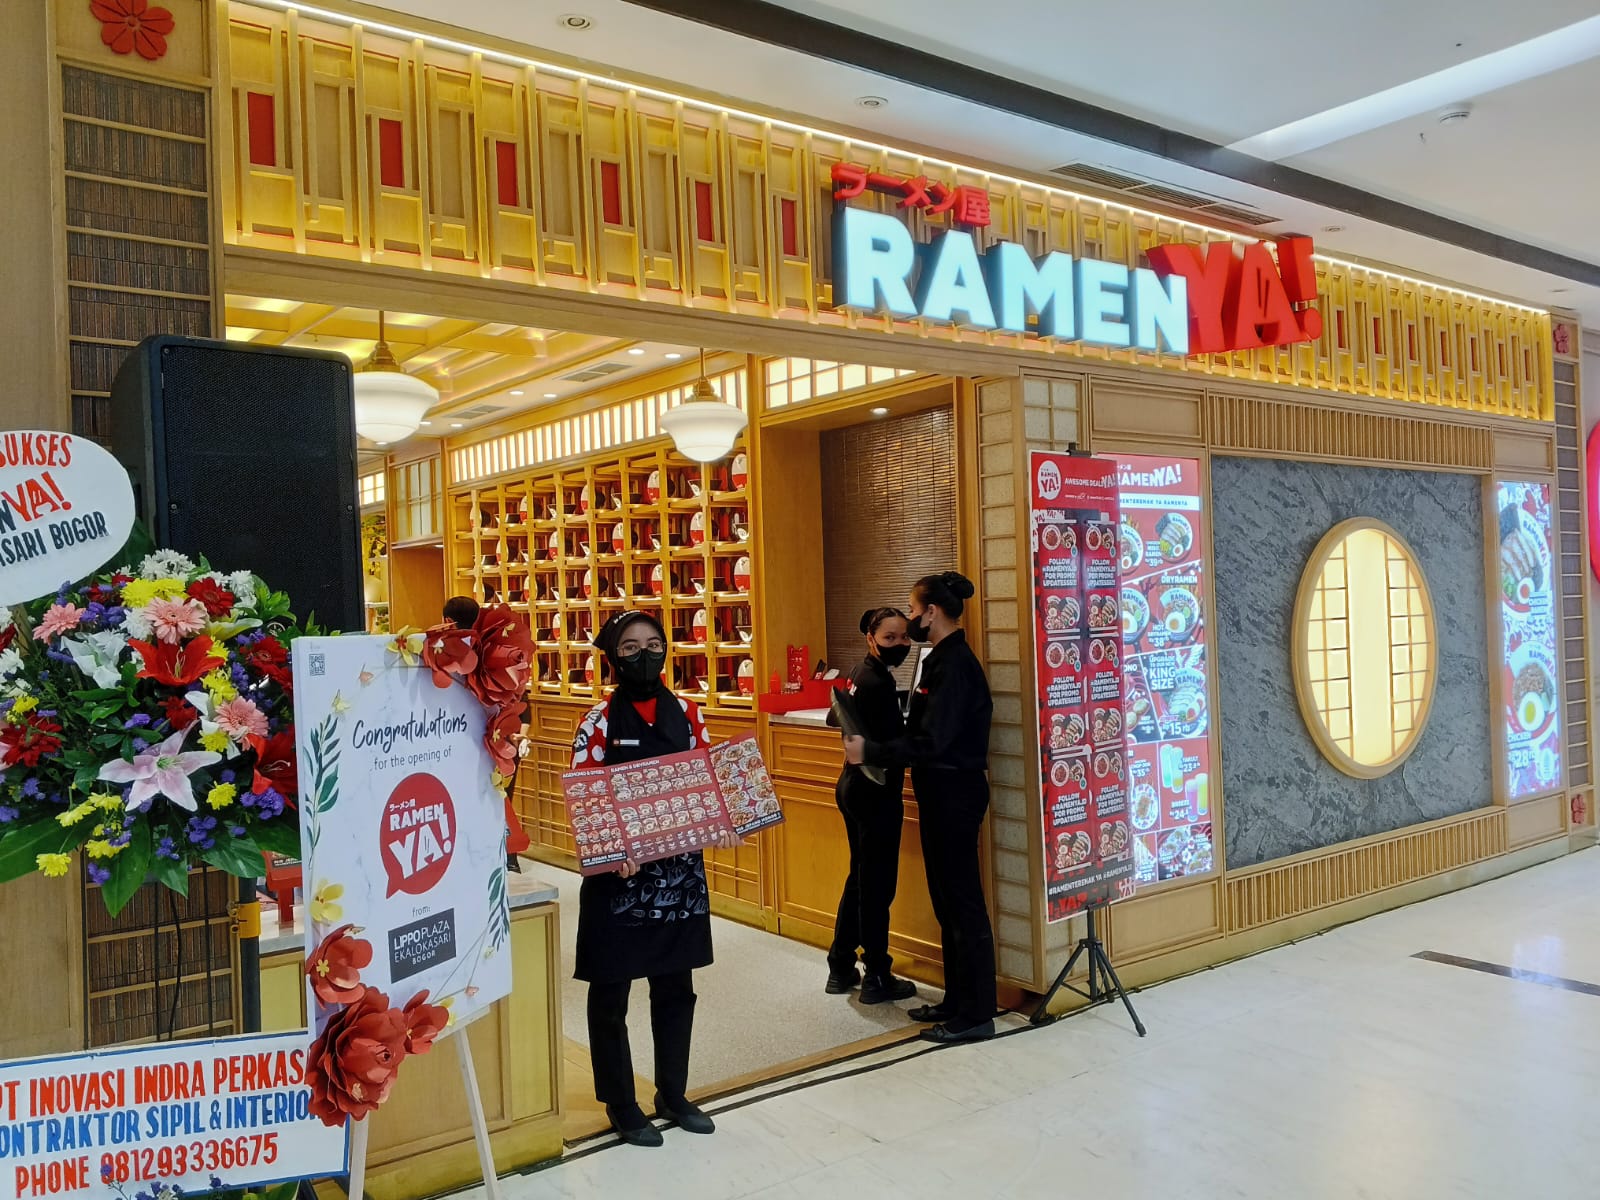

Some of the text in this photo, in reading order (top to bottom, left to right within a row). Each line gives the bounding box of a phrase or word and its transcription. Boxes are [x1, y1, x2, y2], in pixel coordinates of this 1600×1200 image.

[831, 162, 991, 228] ラーメン屋
[48, 511, 110, 550] BOGOR
[1161, 575, 1198, 585] DRYRAMEN
[1053, 675, 1075, 684] FOLLOW
[1149, 667, 1176, 679] KING
[1151, 678, 1175, 690] SIZE
[352, 708, 468, 754] Congratulations
[374, 745, 452, 770] for the opening of
[1058, 793, 1080, 803] FOLLOW
[390, 803, 444, 831] RAMEN
[388, 813, 452, 879] YA!
[394, 932, 451, 963] EKALOKASARI
[412, 950, 436, 965] BOGOR
[29, 1069, 125, 1117] INOVASI
[134, 1060, 206, 1104] INDRA
[213, 1049, 310, 1095] PERKAS
[146, 1102, 206, 1138] SIPIL
[210, 1100, 222, 1131] &
[226, 1088, 320, 1129] INTERIO
[15, 1155, 90, 1199] PHONE
